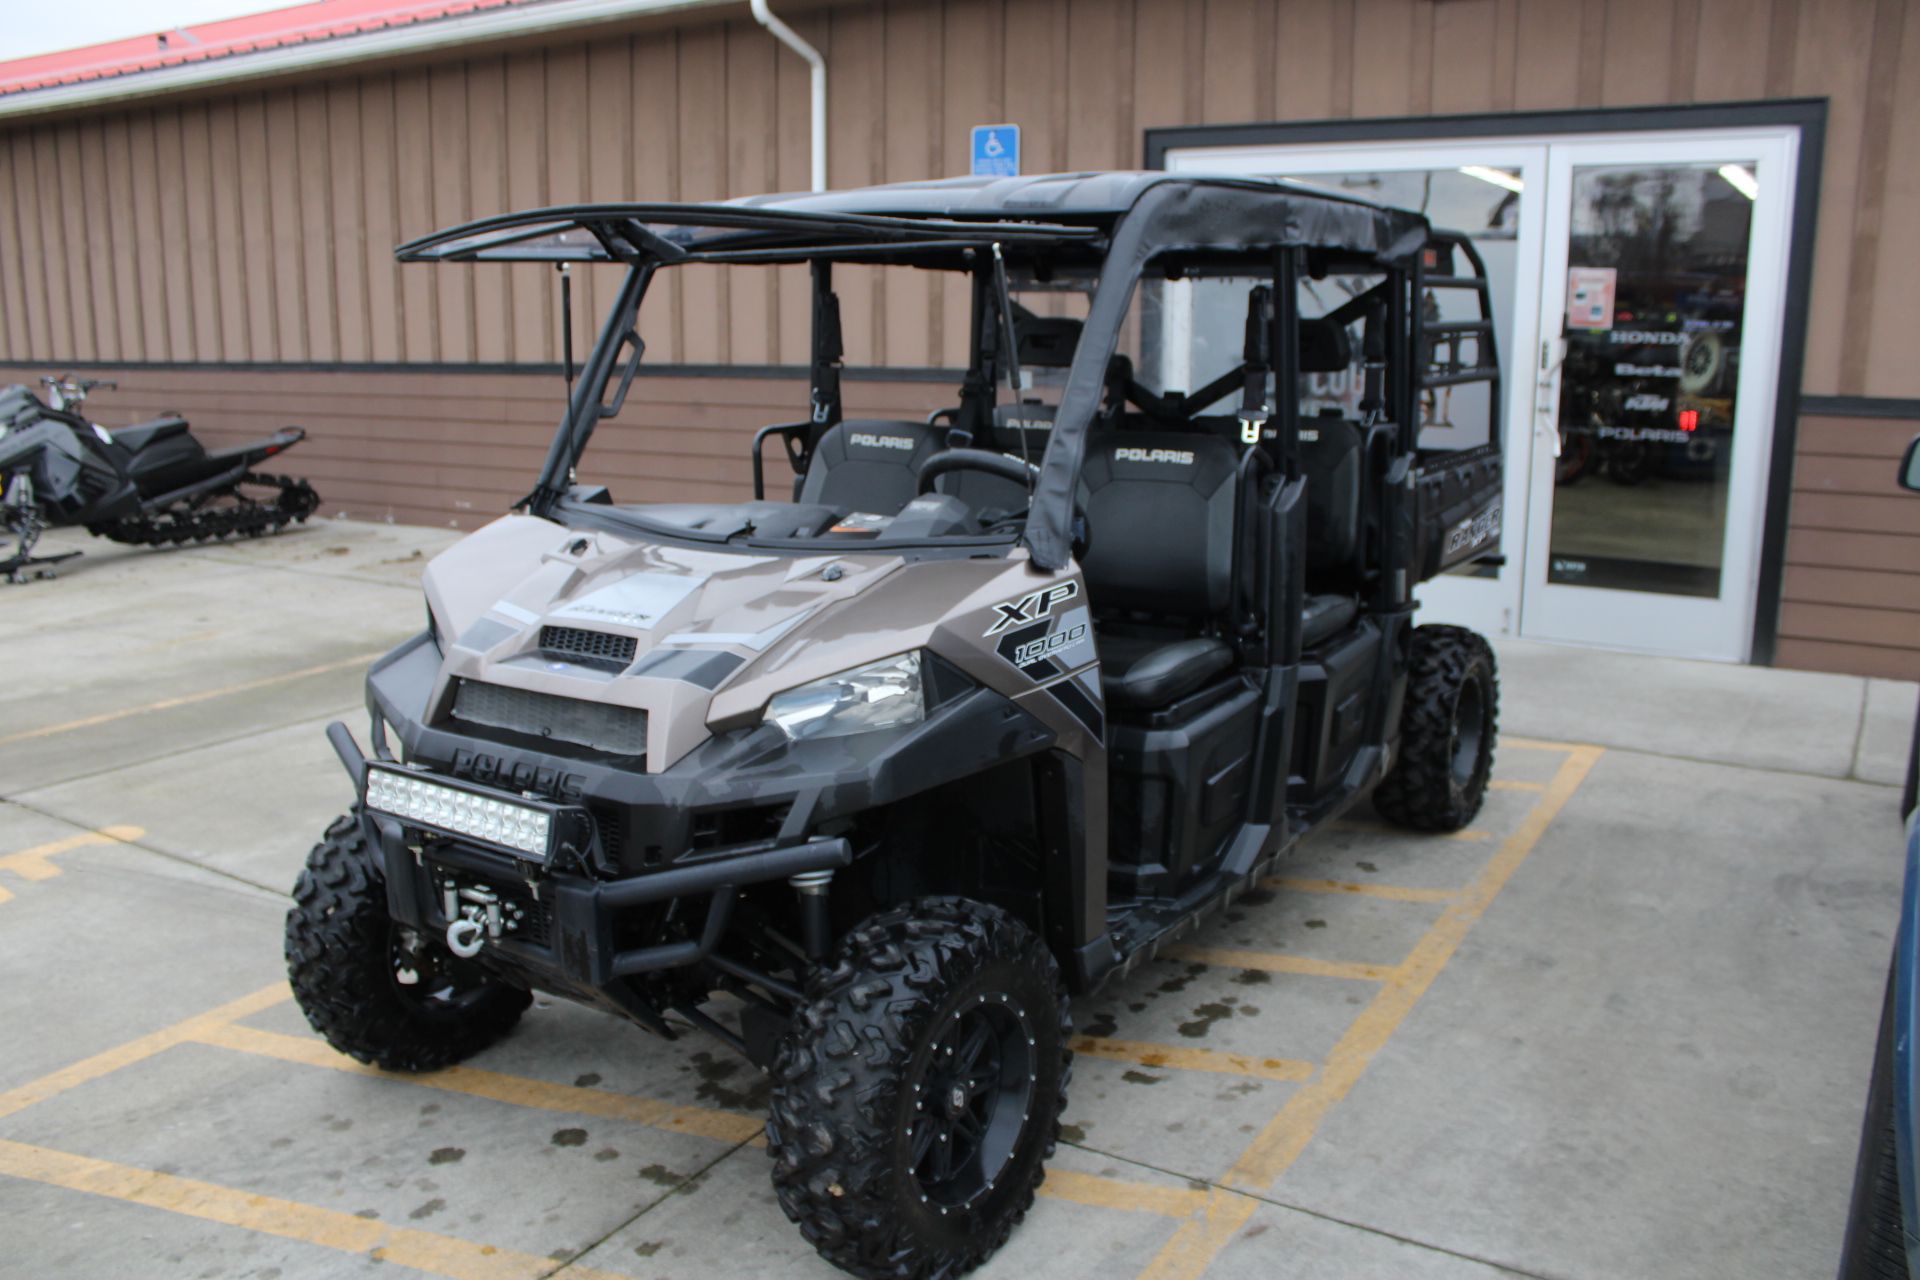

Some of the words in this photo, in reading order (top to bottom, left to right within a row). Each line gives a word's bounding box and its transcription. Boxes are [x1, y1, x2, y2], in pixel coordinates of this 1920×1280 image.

[1610, 330, 1691, 345] HONDA
[850, 433, 914, 450] POLARIS
[1599, 426, 1690, 443] POLARIS
[1115, 448, 1195, 465] POLARIS
[982, 579, 1079, 637] XP
[1014, 623, 1086, 664] 1000
[450, 747, 587, 802] POLARIS
